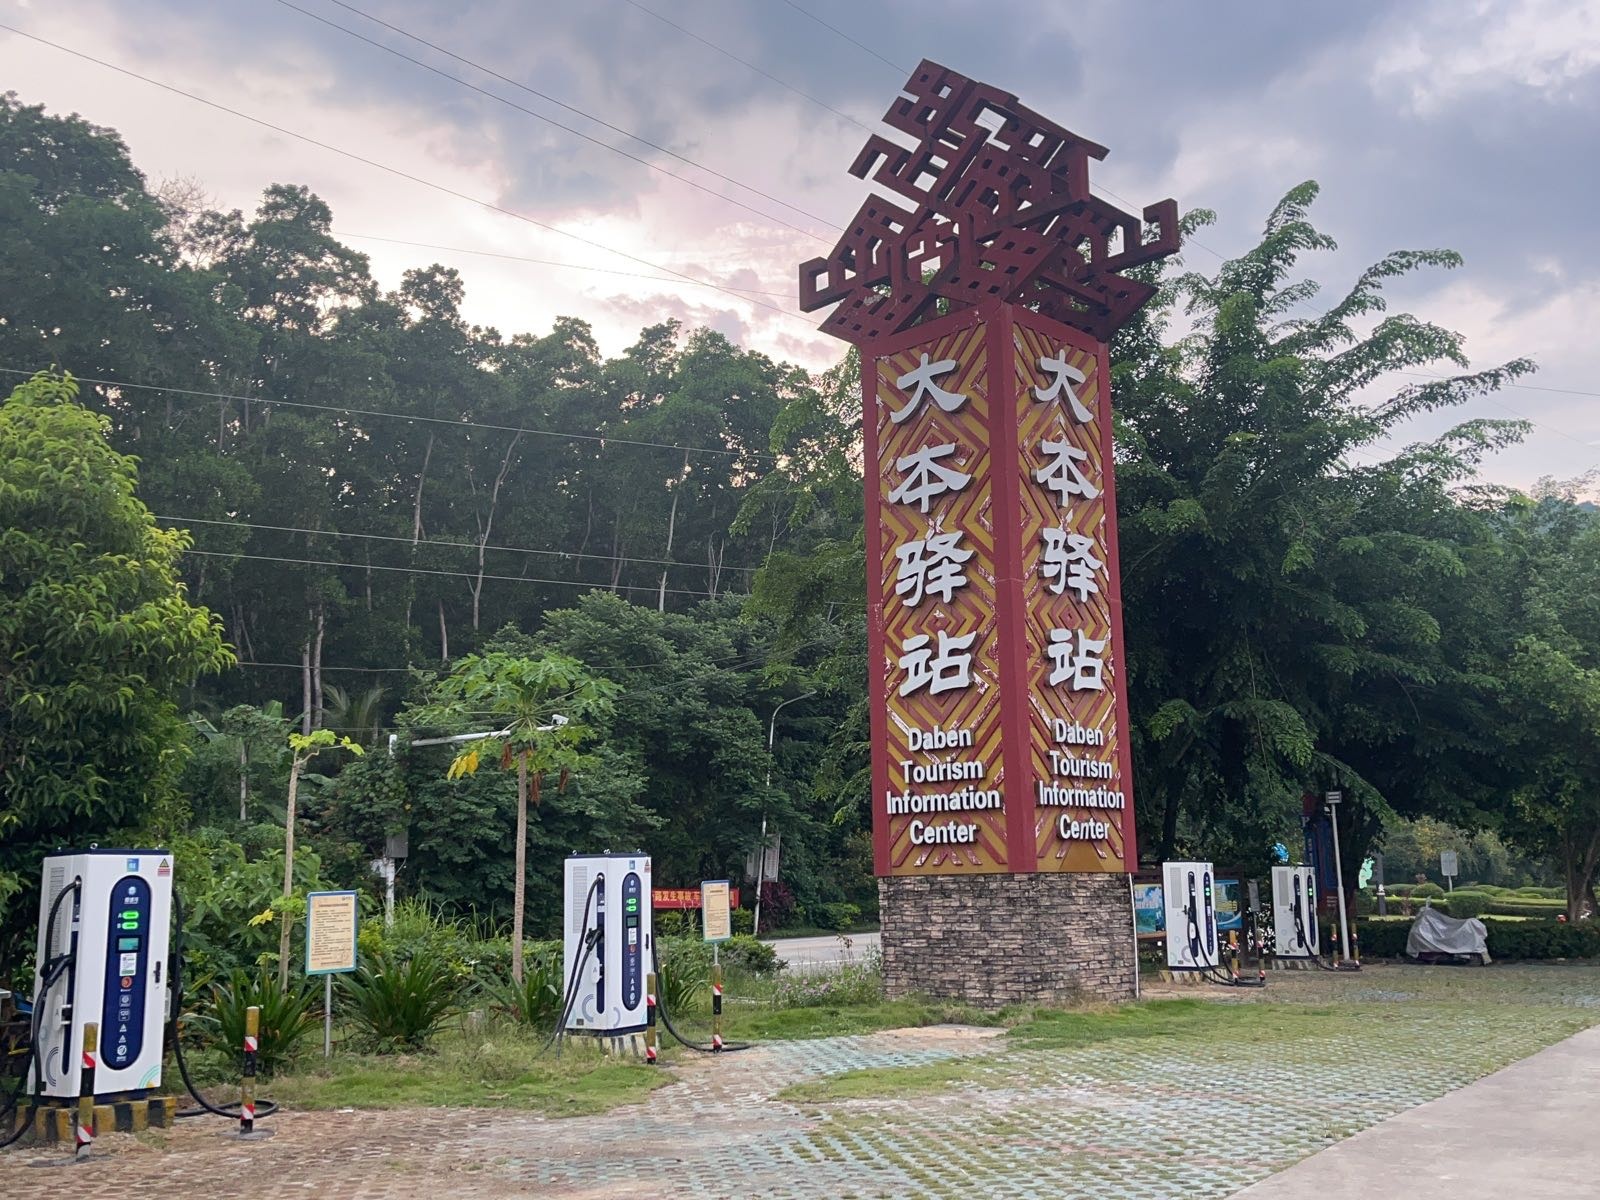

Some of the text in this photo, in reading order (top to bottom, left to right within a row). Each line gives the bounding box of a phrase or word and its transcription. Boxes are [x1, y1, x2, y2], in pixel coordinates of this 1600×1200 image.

[888, 352, 977, 697] 大本驿站
[1034, 349, 1105, 691] 大本驿站
[908, 725, 972, 751] Daben
[1054, 719, 1104, 746] Daben
[900, 757, 984, 783] Tourism
[1050, 751, 1113, 779] Tourism
[886, 785, 1000, 814] Information
[1039, 780, 1125, 809] Information
[909, 819, 977, 844] Center
[1059, 814, 1110, 839] Center
